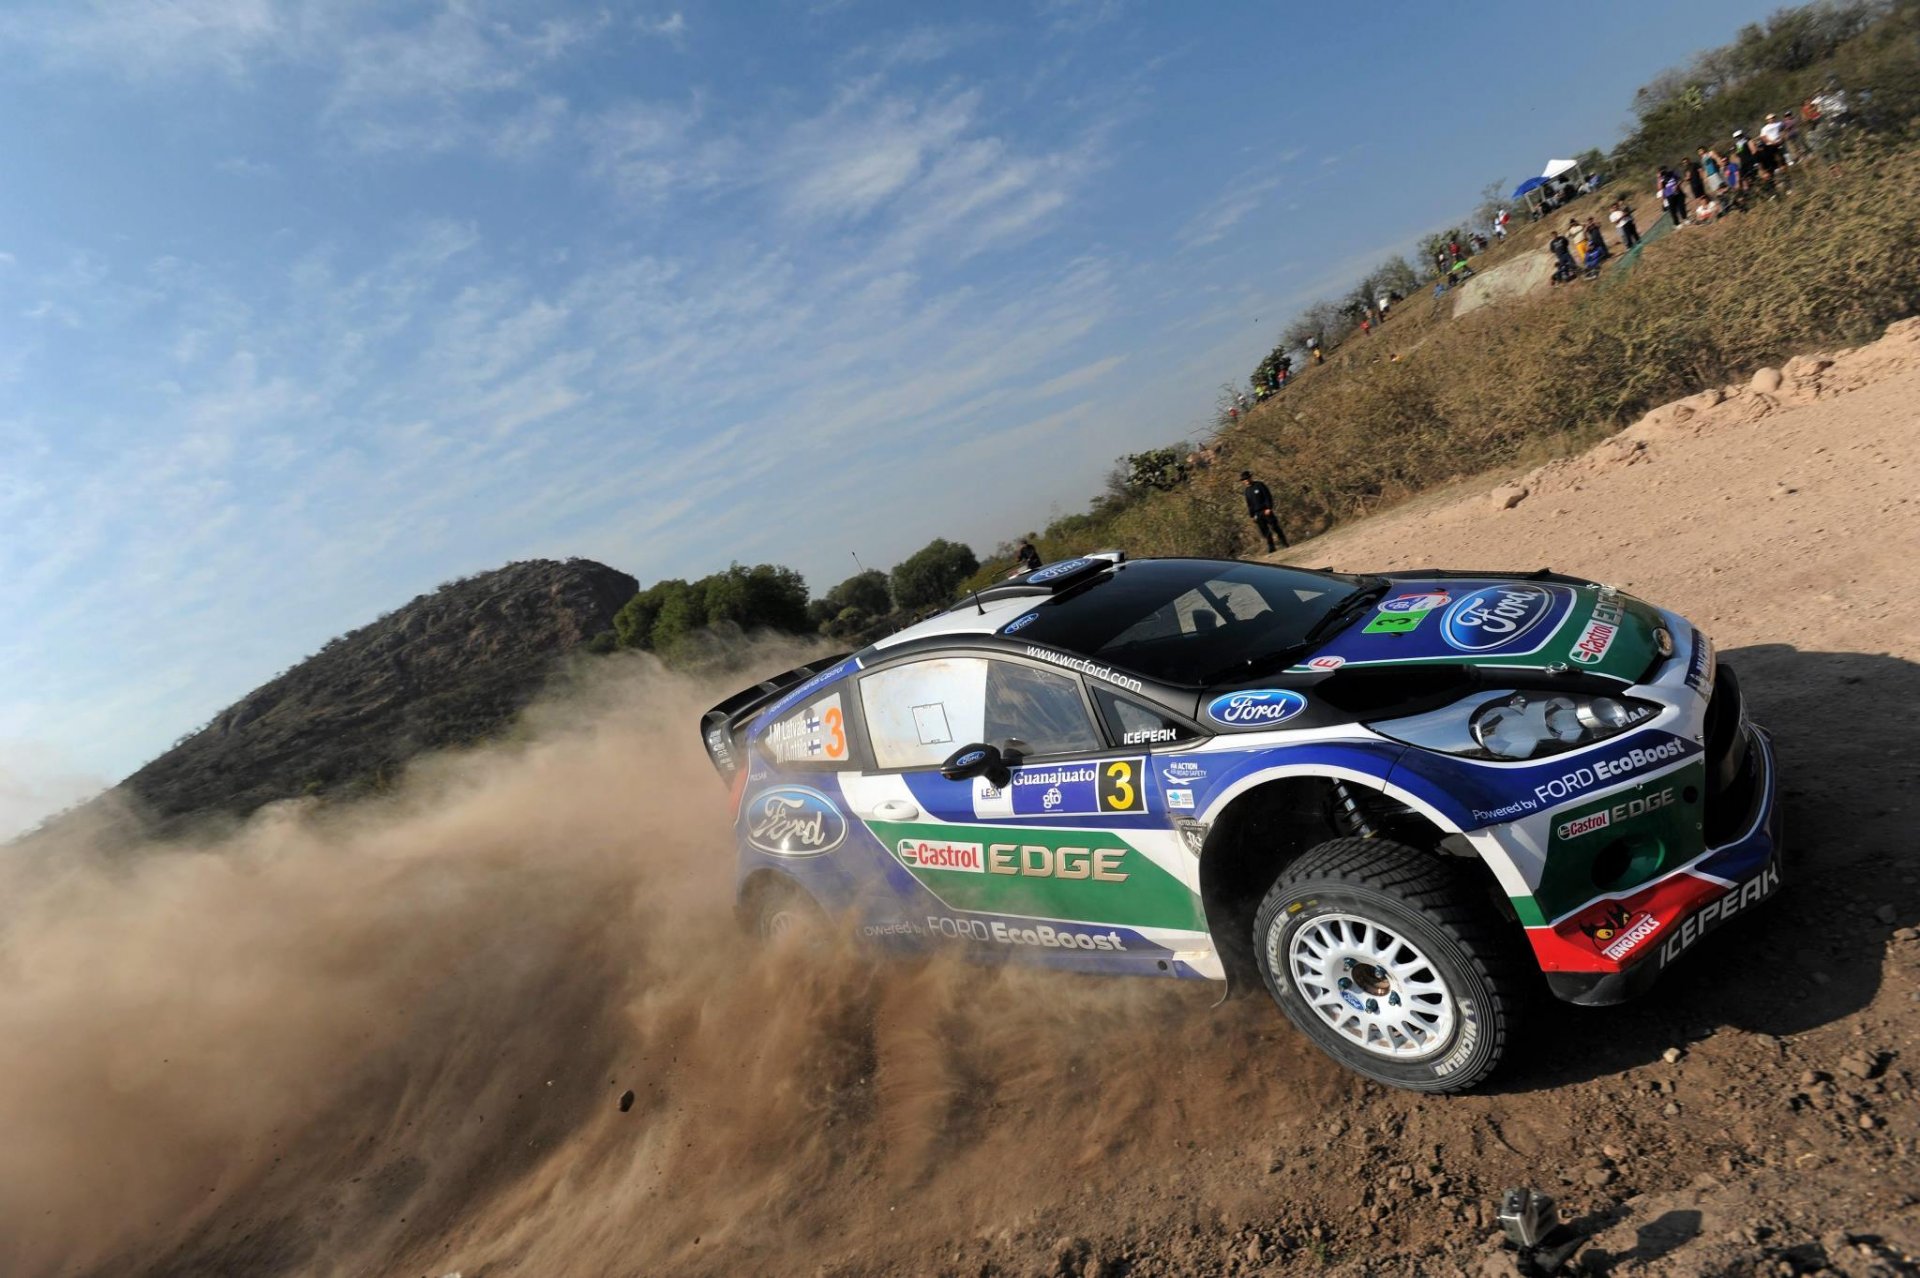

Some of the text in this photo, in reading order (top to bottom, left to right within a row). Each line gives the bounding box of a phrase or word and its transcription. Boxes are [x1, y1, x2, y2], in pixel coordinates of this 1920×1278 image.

[1456, 590, 1539, 633] Ford
[1579, 622, 1614, 654] Castrol
[1026, 644, 1142, 693] www.wrcford.com
[1223, 694, 1287, 721] Ford
[1613, 706, 1650, 728] PIAA
[824, 707, 845, 758] 3
[1123, 728, 1177, 745] ICEPEAK
[1013, 768, 1095, 787] Guanajuato
[1107, 761, 1134, 810] 3
[1472, 738, 1685, 821] Powered by FORD EcoBoost
[753, 796, 825, 846] Ford
[1568, 786, 1676, 836] Castrol EDGE
[918, 843, 1130, 882] Castrol EDGE
[927, 916, 990, 941] FORD
[990, 923, 1128, 952] EcoBoost
[1659, 862, 1780, 969] ICEPEAK
[1266, 911, 1290, 972] MICHELIN
[1435, 1019, 1477, 1077] MICHELIN
